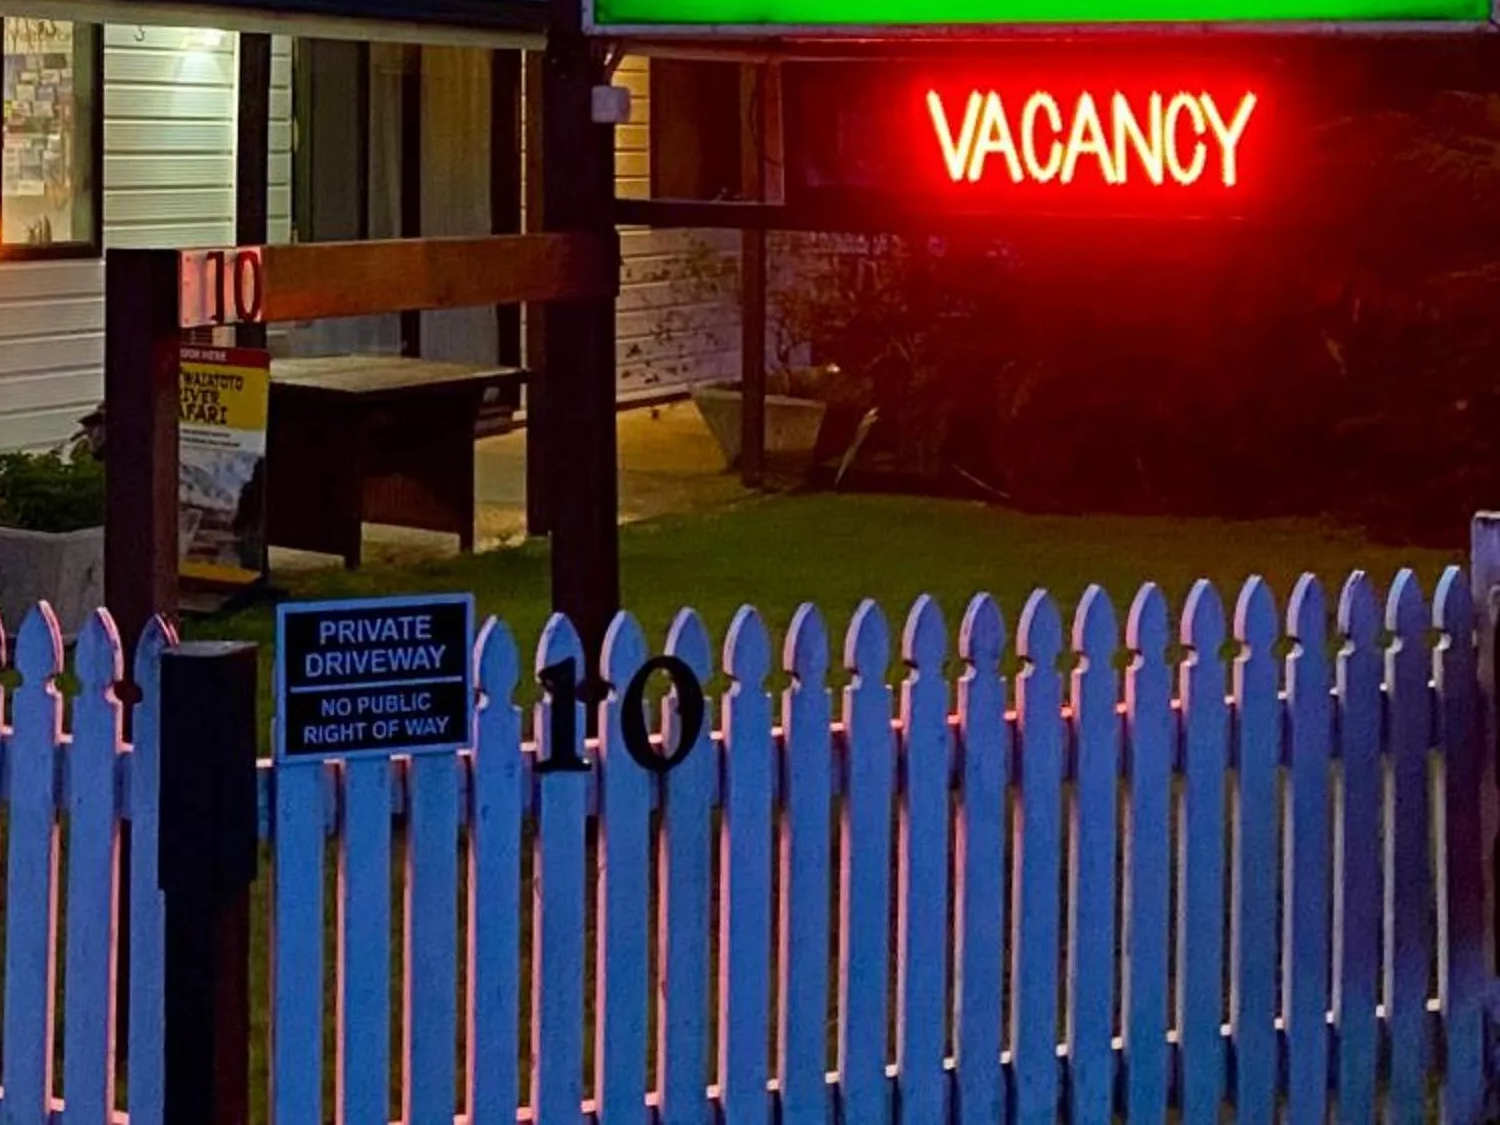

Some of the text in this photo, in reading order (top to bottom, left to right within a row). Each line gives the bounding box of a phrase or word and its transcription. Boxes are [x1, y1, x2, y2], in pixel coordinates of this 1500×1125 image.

[926, 90, 1257, 186] VACANCY
[206, 251, 262, 323] 10
[319, 615, 432, 645] PRIVATE
[305, 644, 447, 678] DRIVEWAY
[321, 692, 432, 717] NO PUBLIC
[536, 656, 704, 773] 10
[303, 716, 449, 744] RIGHT OF WAY
